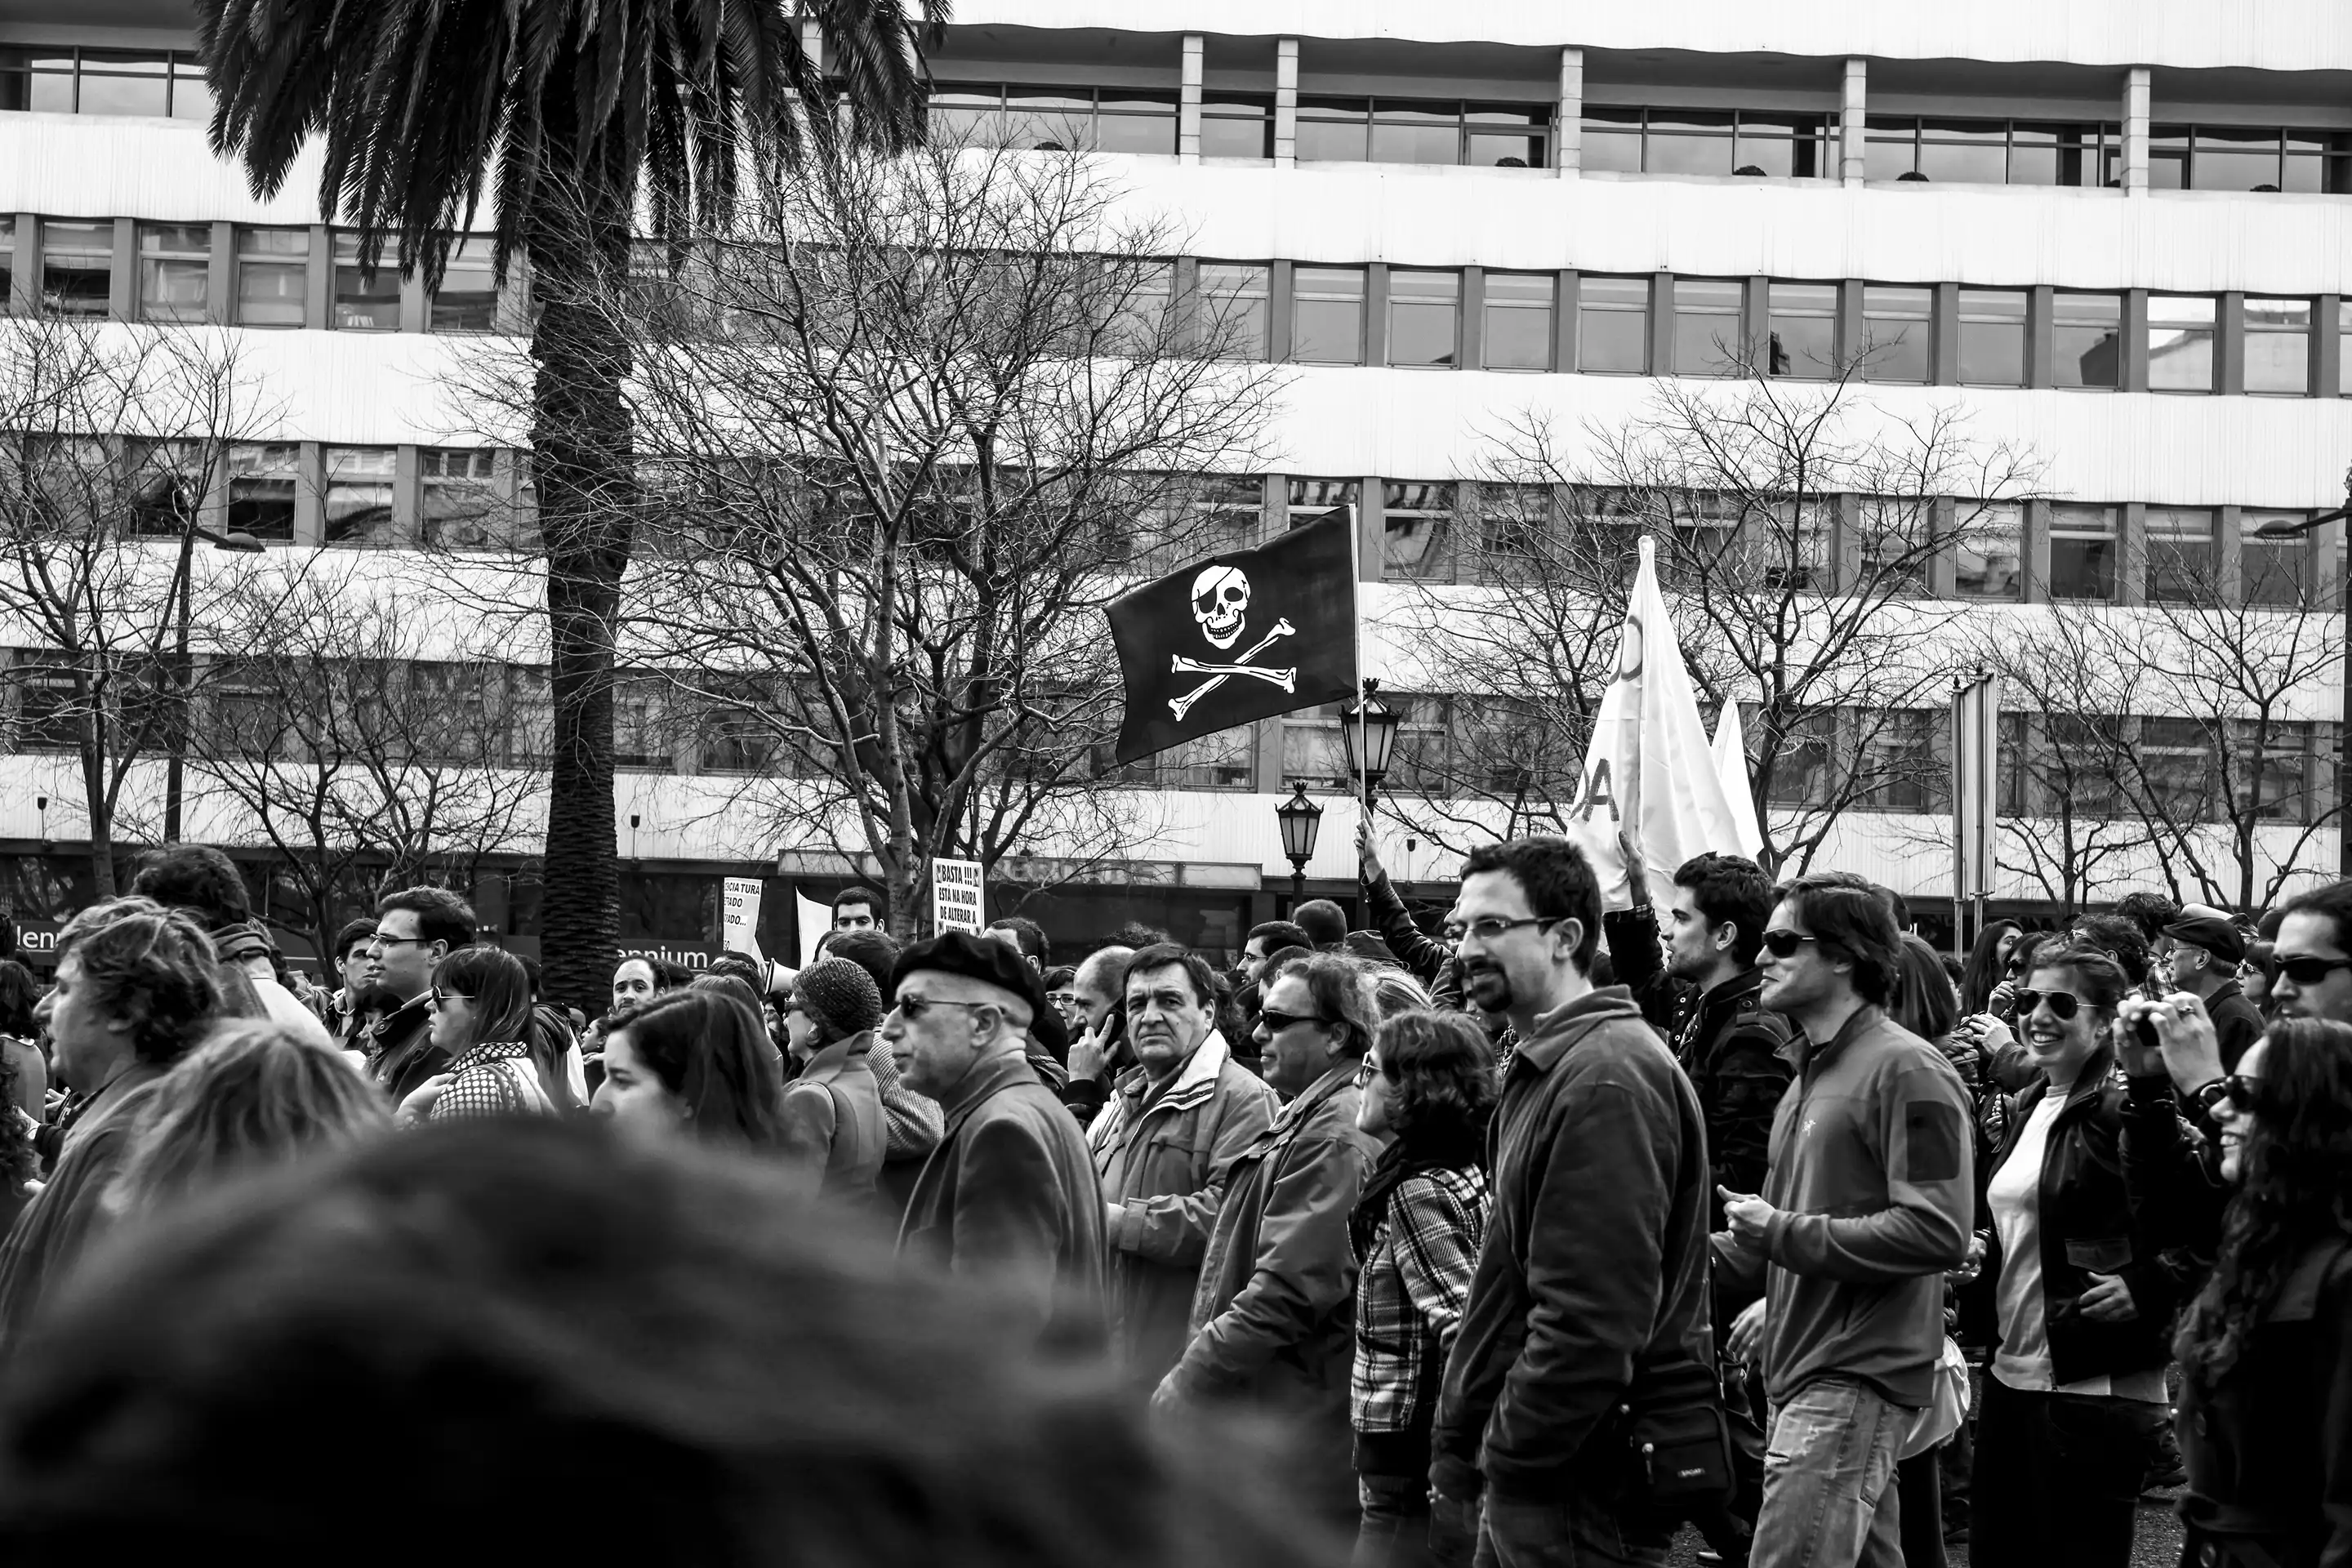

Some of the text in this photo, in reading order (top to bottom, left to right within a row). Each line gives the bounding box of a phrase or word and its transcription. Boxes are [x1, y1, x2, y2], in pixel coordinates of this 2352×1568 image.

[942, 865, 963, 884] BASTA
[964, 866, 973, 885] !!!
[741, 884, 760, 895] TURA
[938, 884, 977, 906] ESTÁ NA HORA
[940, 906, 977, 924] DE ALTERAR A
